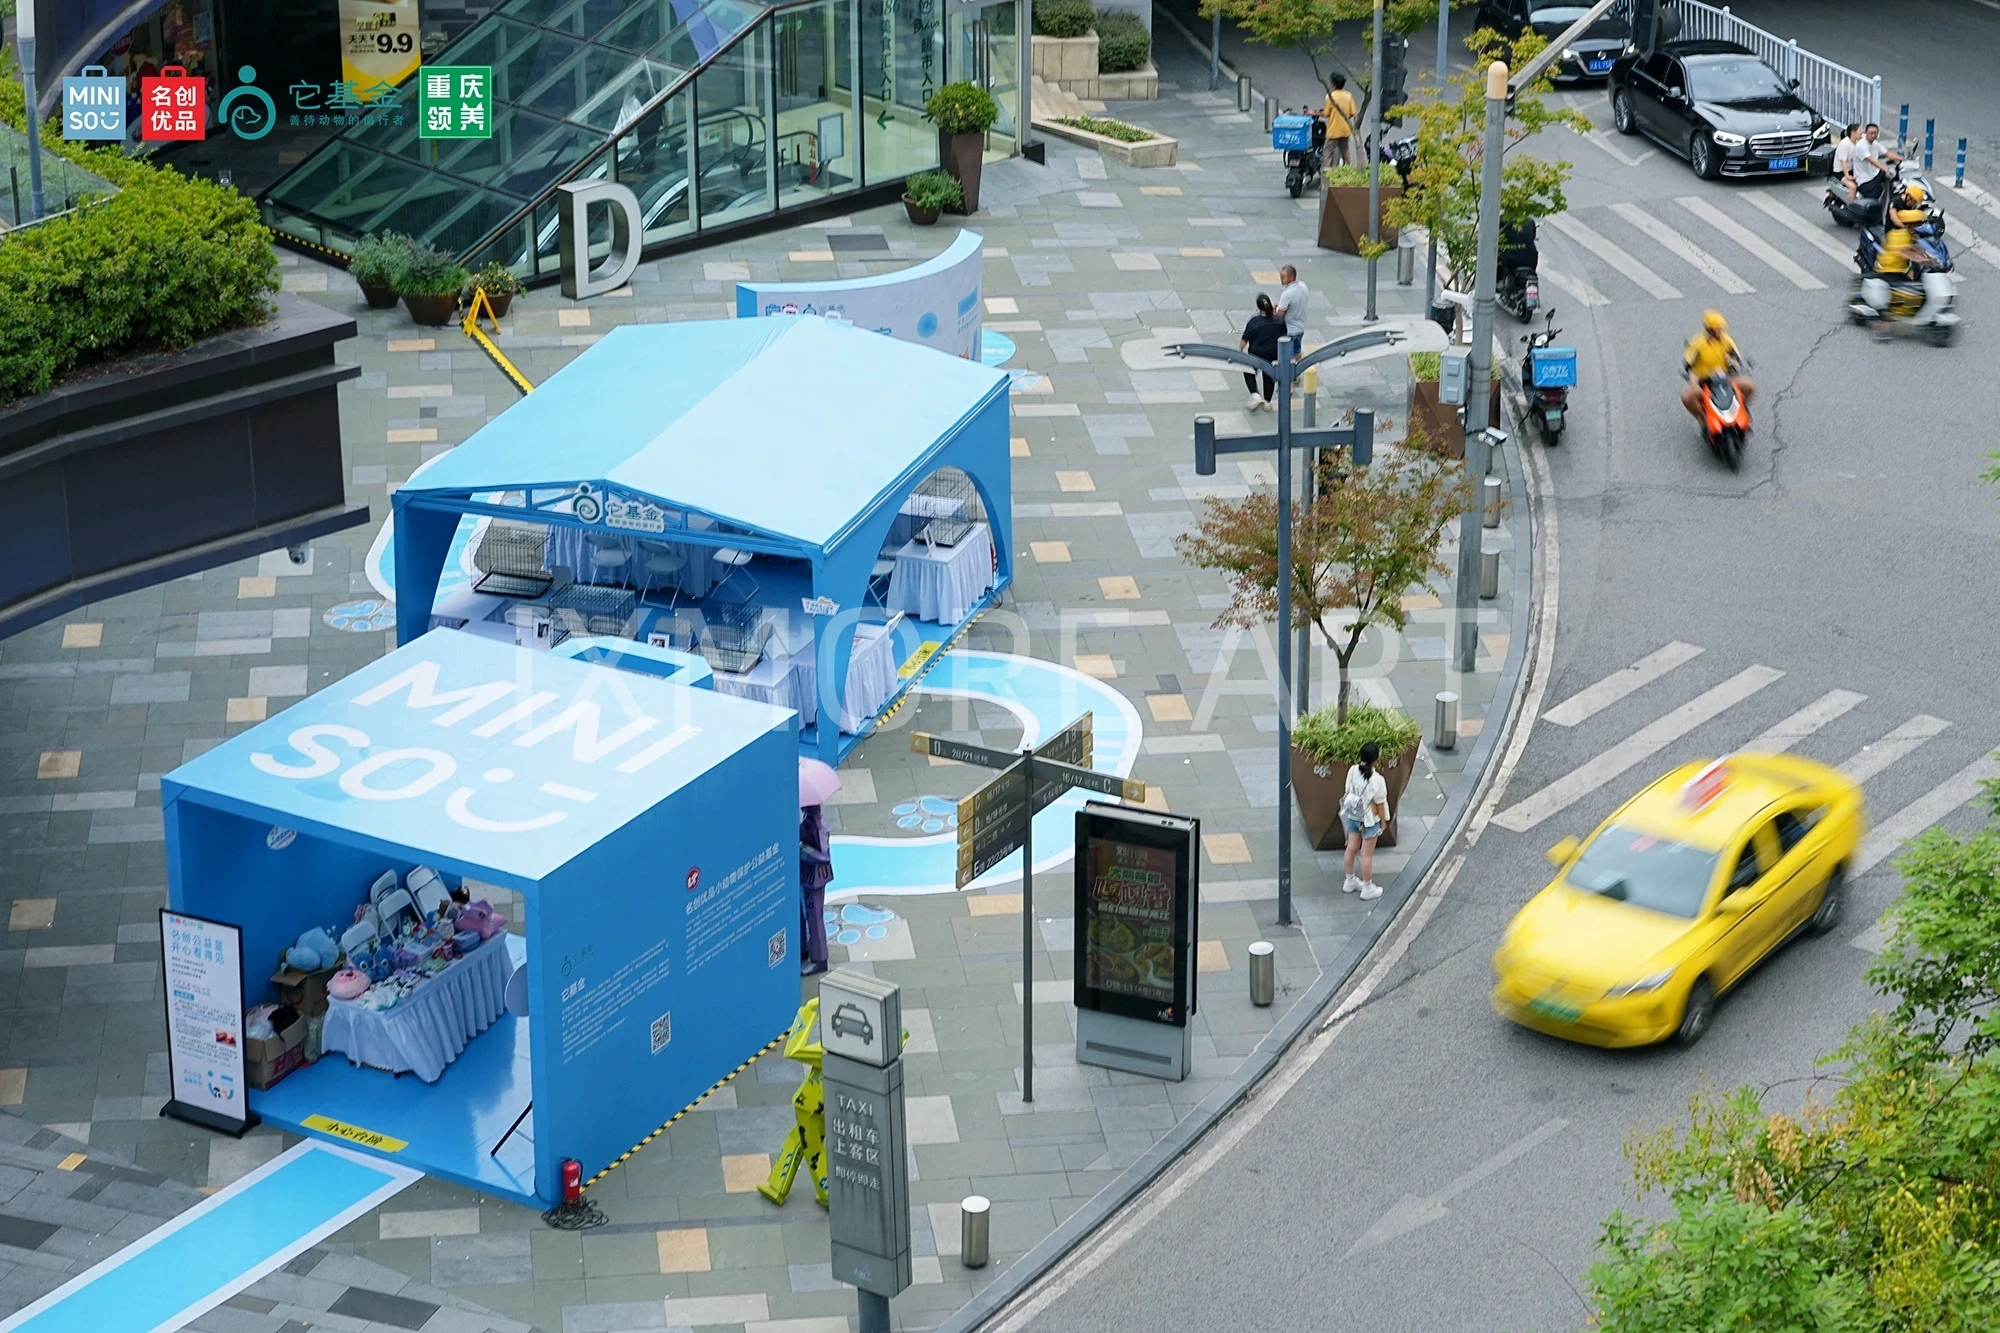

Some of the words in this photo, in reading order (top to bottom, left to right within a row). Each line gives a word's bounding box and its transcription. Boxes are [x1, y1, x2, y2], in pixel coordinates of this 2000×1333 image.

[572, 183, 643, 300] D
[607, 502, 662, 521] 它基金
[351, 660, 703, 775] MINI
[685, 841, 780, 916] 名创优品小动物保护公益基金
[836, 1092, 874, 1117] TAXI
[324, 1122, 384, 1147] 小心台阶
[832, 1117, 881, 1146] 出租车
[832, 1137, 881, 1167] 上客区
[835, 1164, 881, 1191] 即停即走
